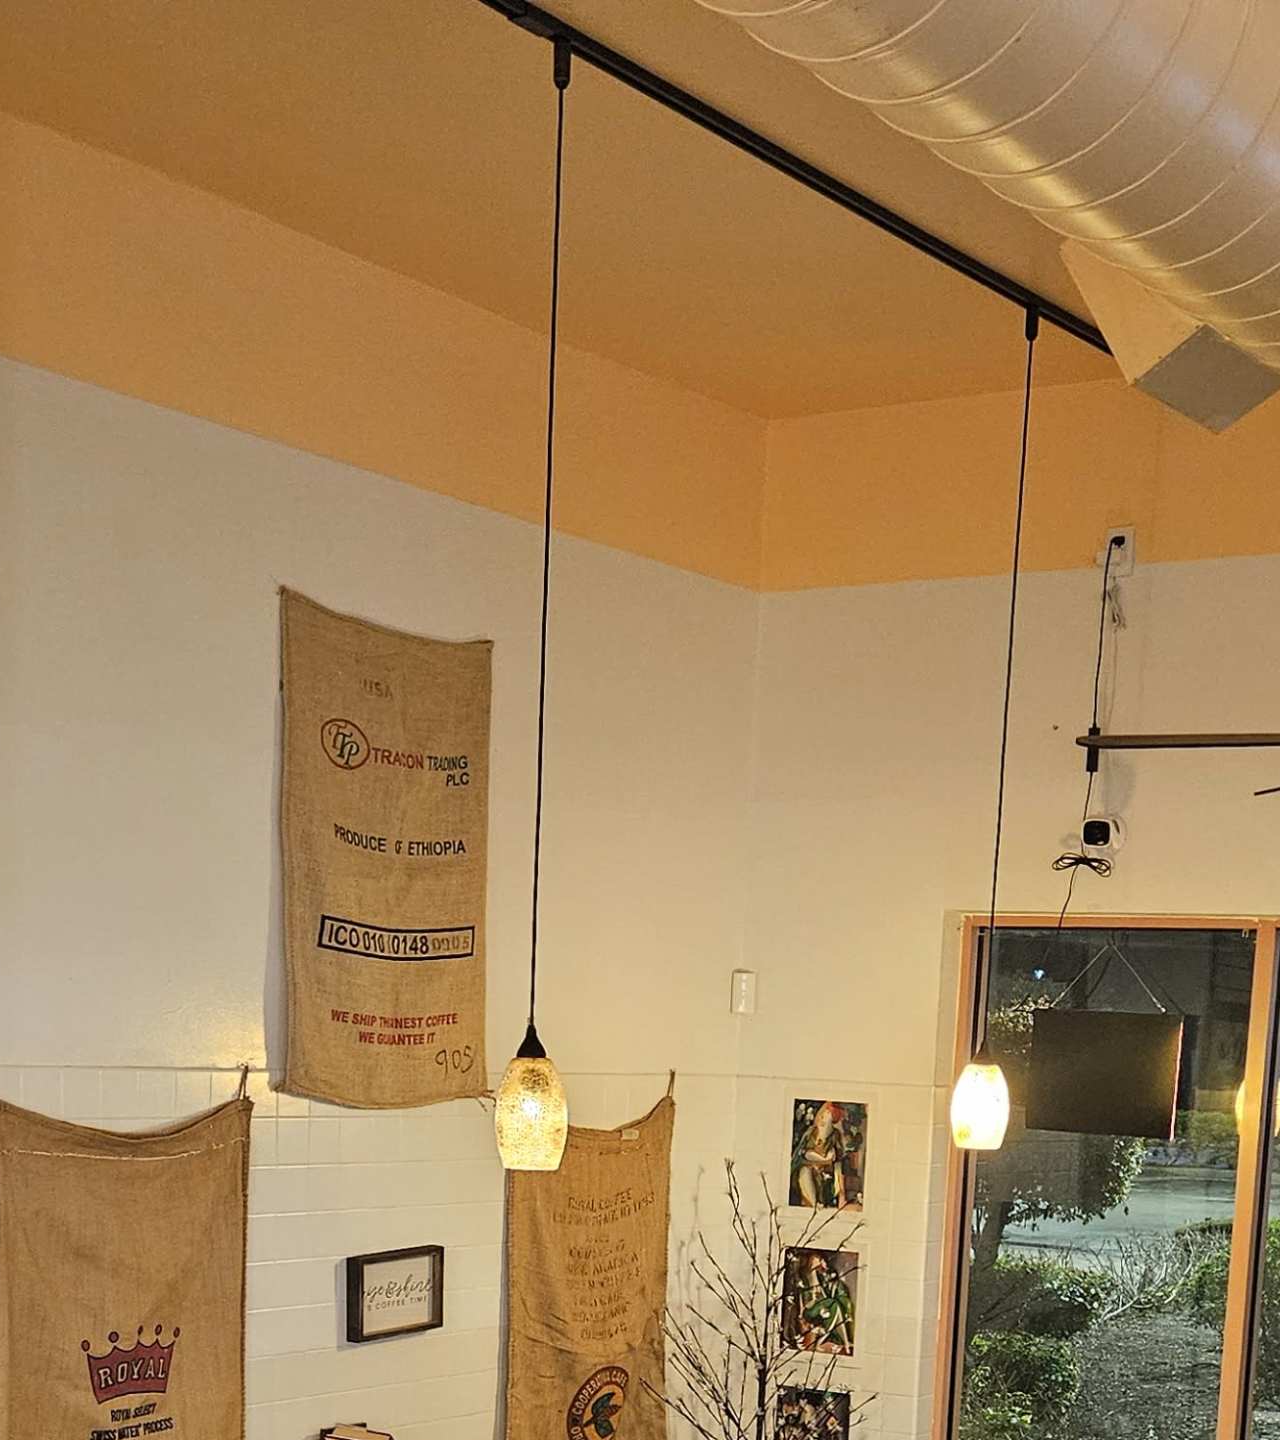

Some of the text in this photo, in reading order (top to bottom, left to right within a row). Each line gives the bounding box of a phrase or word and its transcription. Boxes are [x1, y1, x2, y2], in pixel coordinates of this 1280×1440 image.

[446, 772, 470, 787] PLC
[334, 823, 387, 852] PRODUCE
[407, 839, 466, 856] ETHIOPIA
[328, 923, 360, 948] ICO
[330, 1009, 349, 1023] WE
[351, 1013, 377, 1027] SHIP
[358, 1031, 376, 1044] WE
[426, 1032, 436, 1044] IT
[434, 1045, 474, 1077] 905
[98, 1359, 168, 1389] ROYAL
